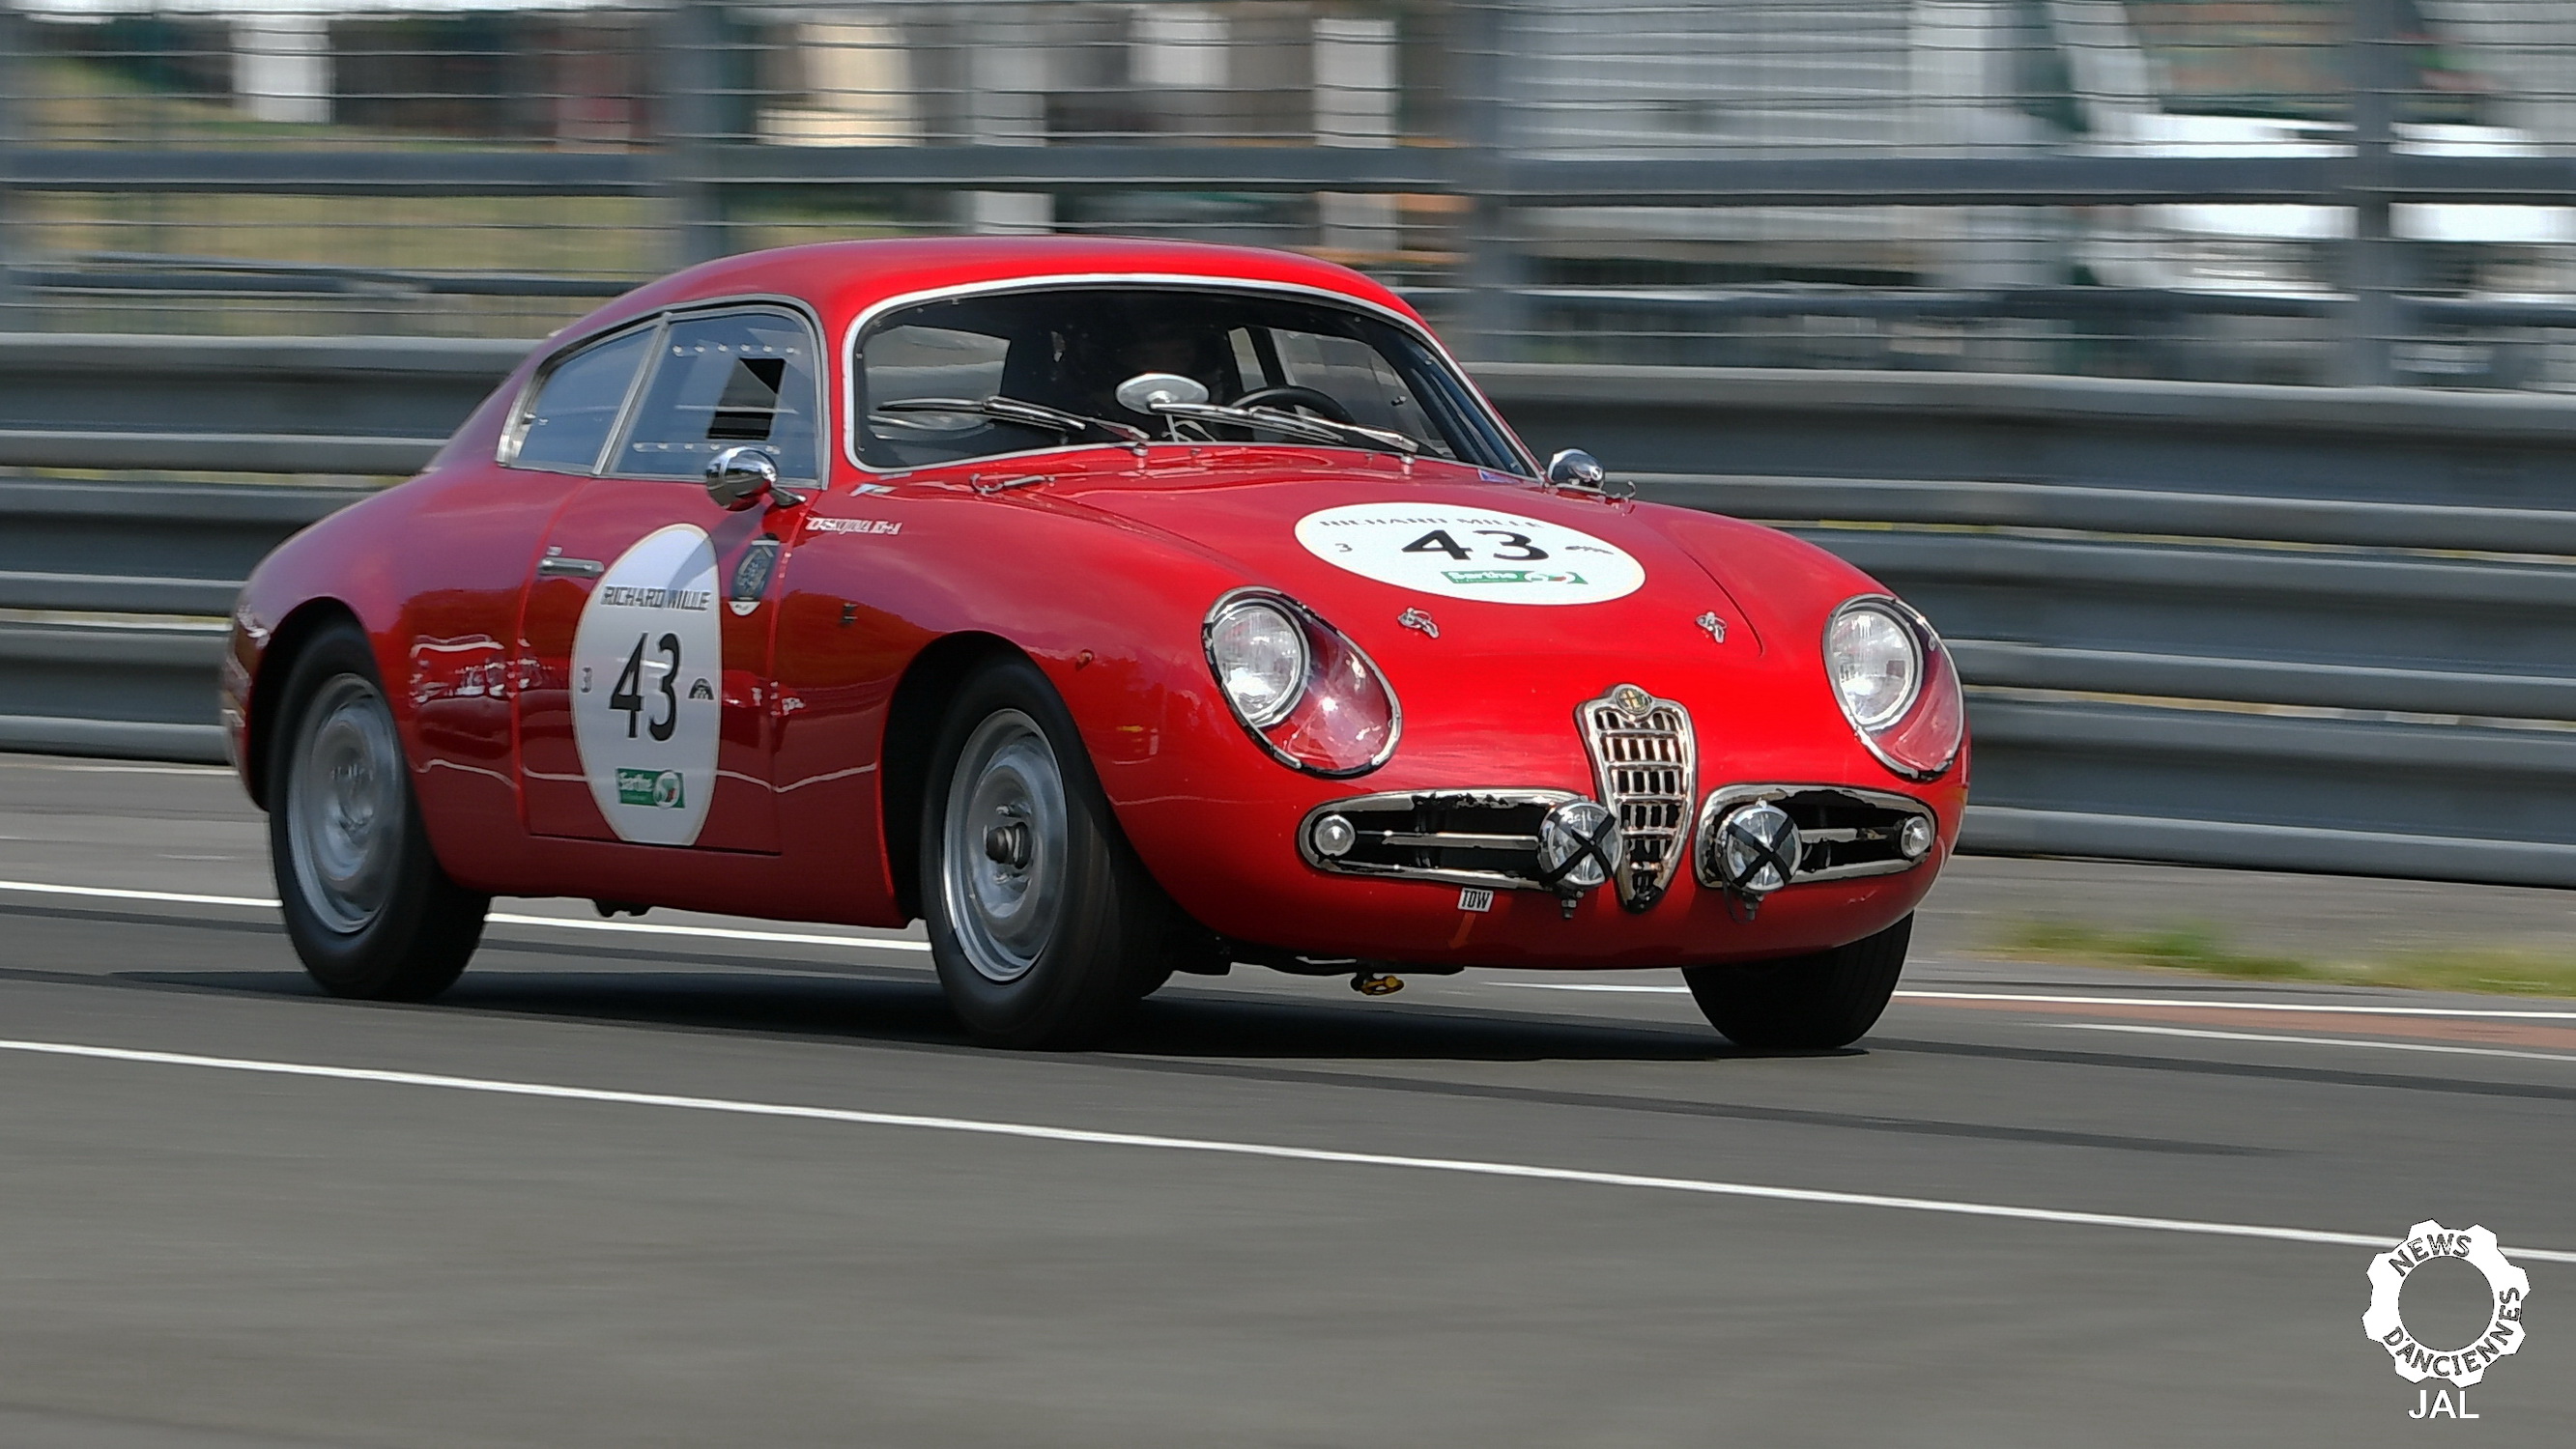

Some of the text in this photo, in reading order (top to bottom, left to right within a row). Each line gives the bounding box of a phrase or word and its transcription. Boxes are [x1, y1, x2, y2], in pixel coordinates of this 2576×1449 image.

[1320, 518, 1544, 528] RICHARD MILLE
[1401, 529, 1549, 560] 43
[600, 585, 667, 609] RICHARD
[609, 633, 680, 741] 43
[1461, 890, 1491, 909] TOW
